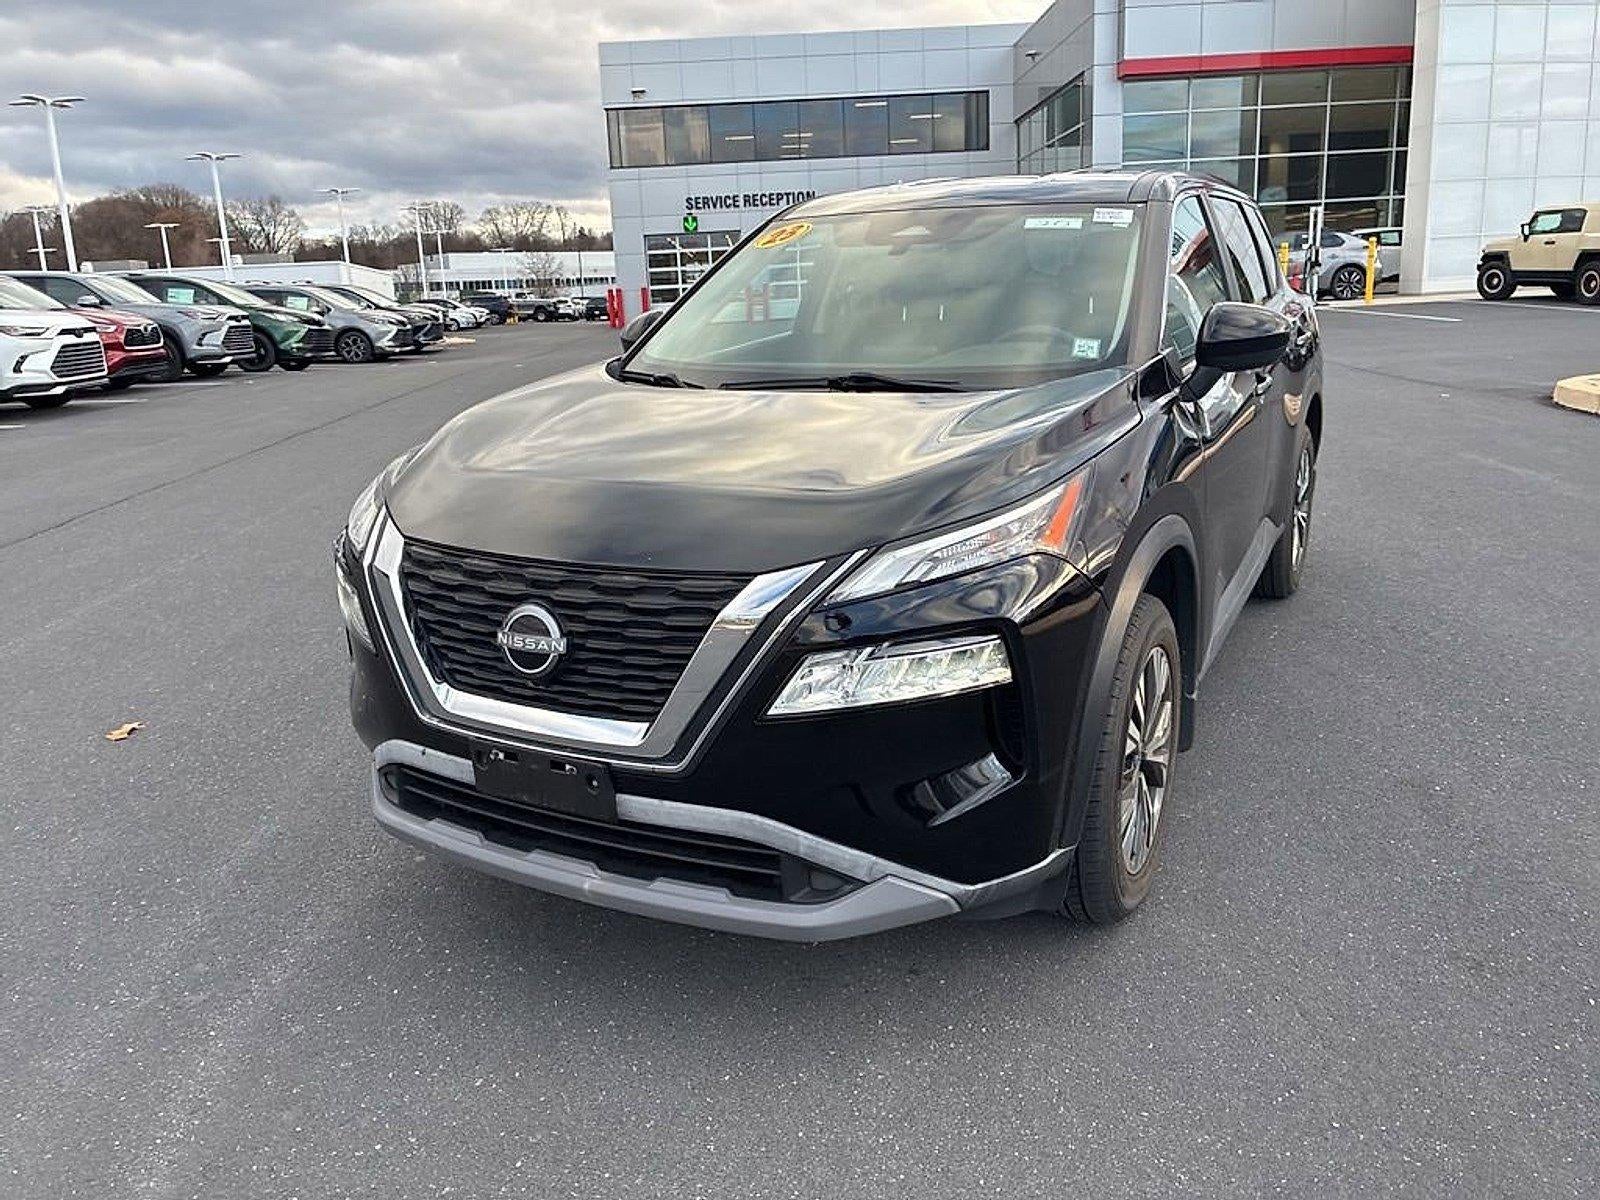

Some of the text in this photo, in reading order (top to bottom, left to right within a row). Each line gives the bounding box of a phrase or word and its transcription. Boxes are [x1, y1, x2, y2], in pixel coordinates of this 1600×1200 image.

[686, 190, 816, 211] SERVICE RECEPTION
[498, 632, 564, 652] NISSAN
